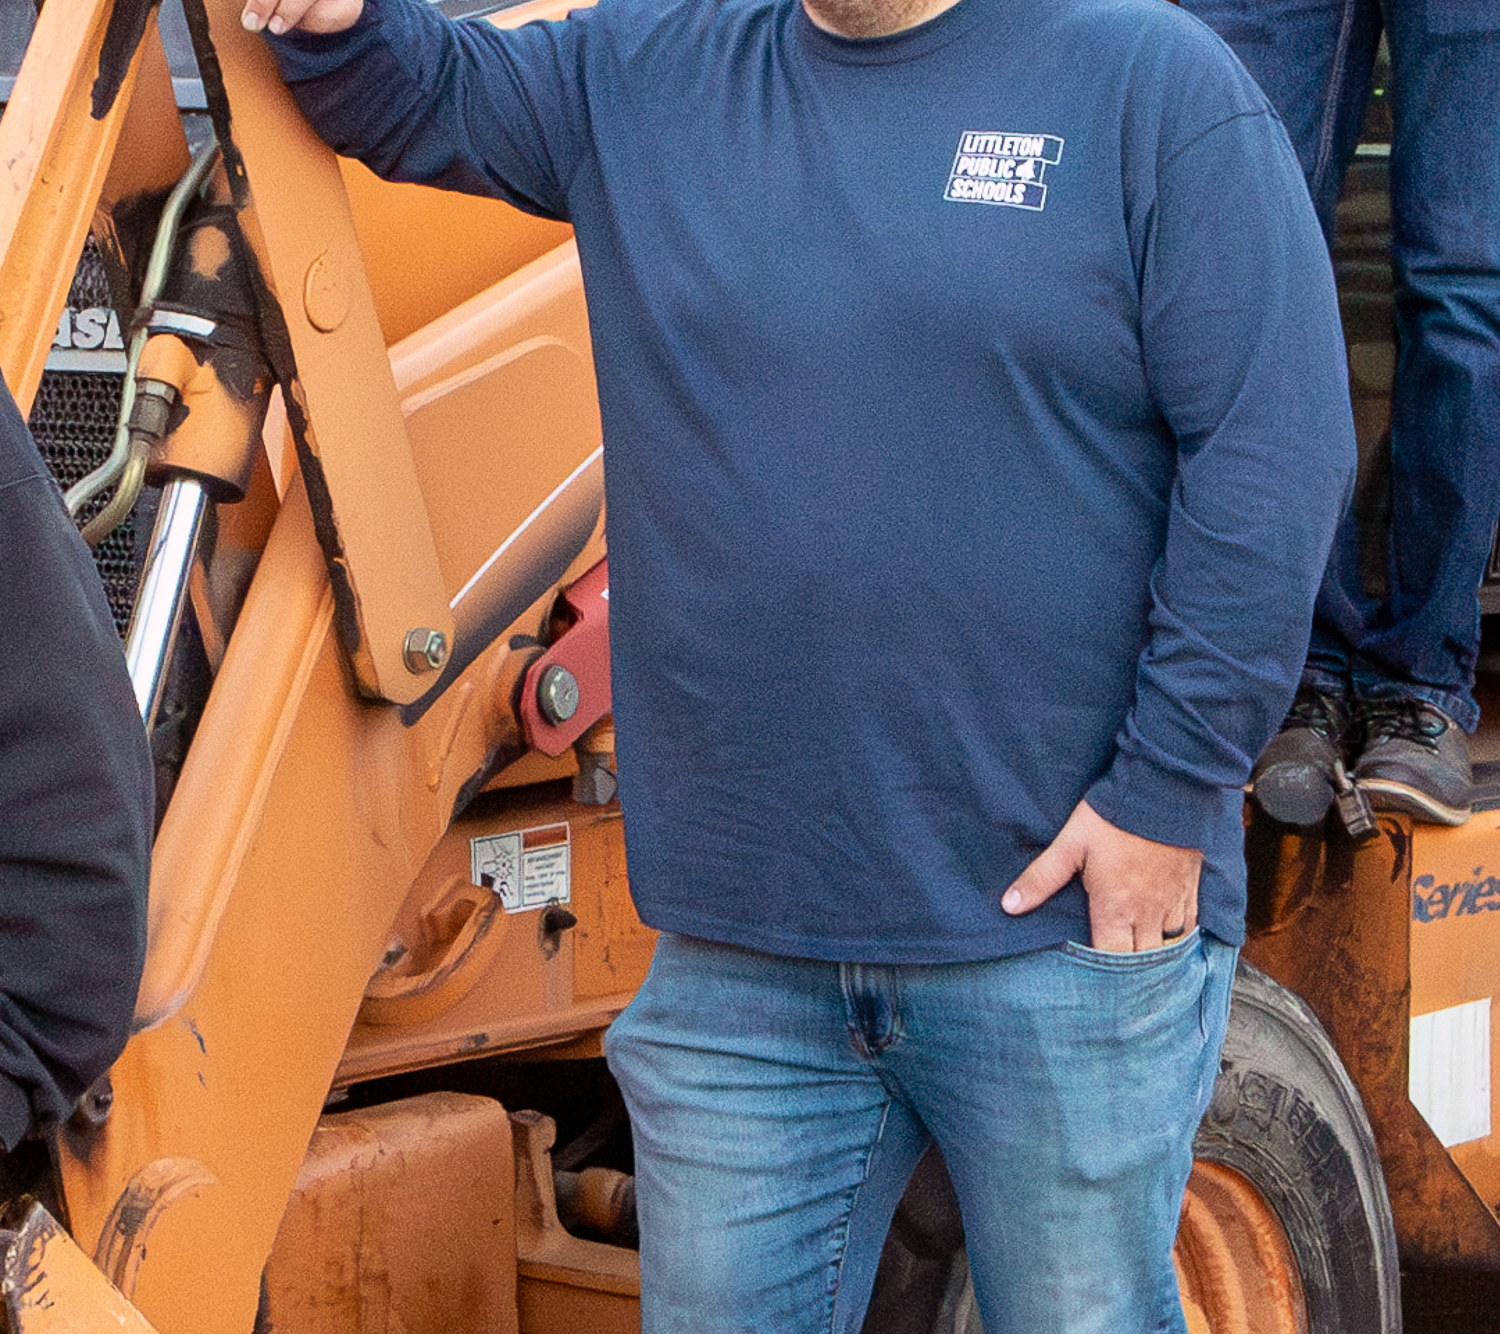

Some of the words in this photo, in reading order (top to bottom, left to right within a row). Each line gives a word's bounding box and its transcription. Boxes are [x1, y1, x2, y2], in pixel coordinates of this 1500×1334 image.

[962, 134, 1045, 157] LITTLETON
[956, 156, 1016, 179] PUBLIC
[951, 178, 1027, 204] SCHOOLS
